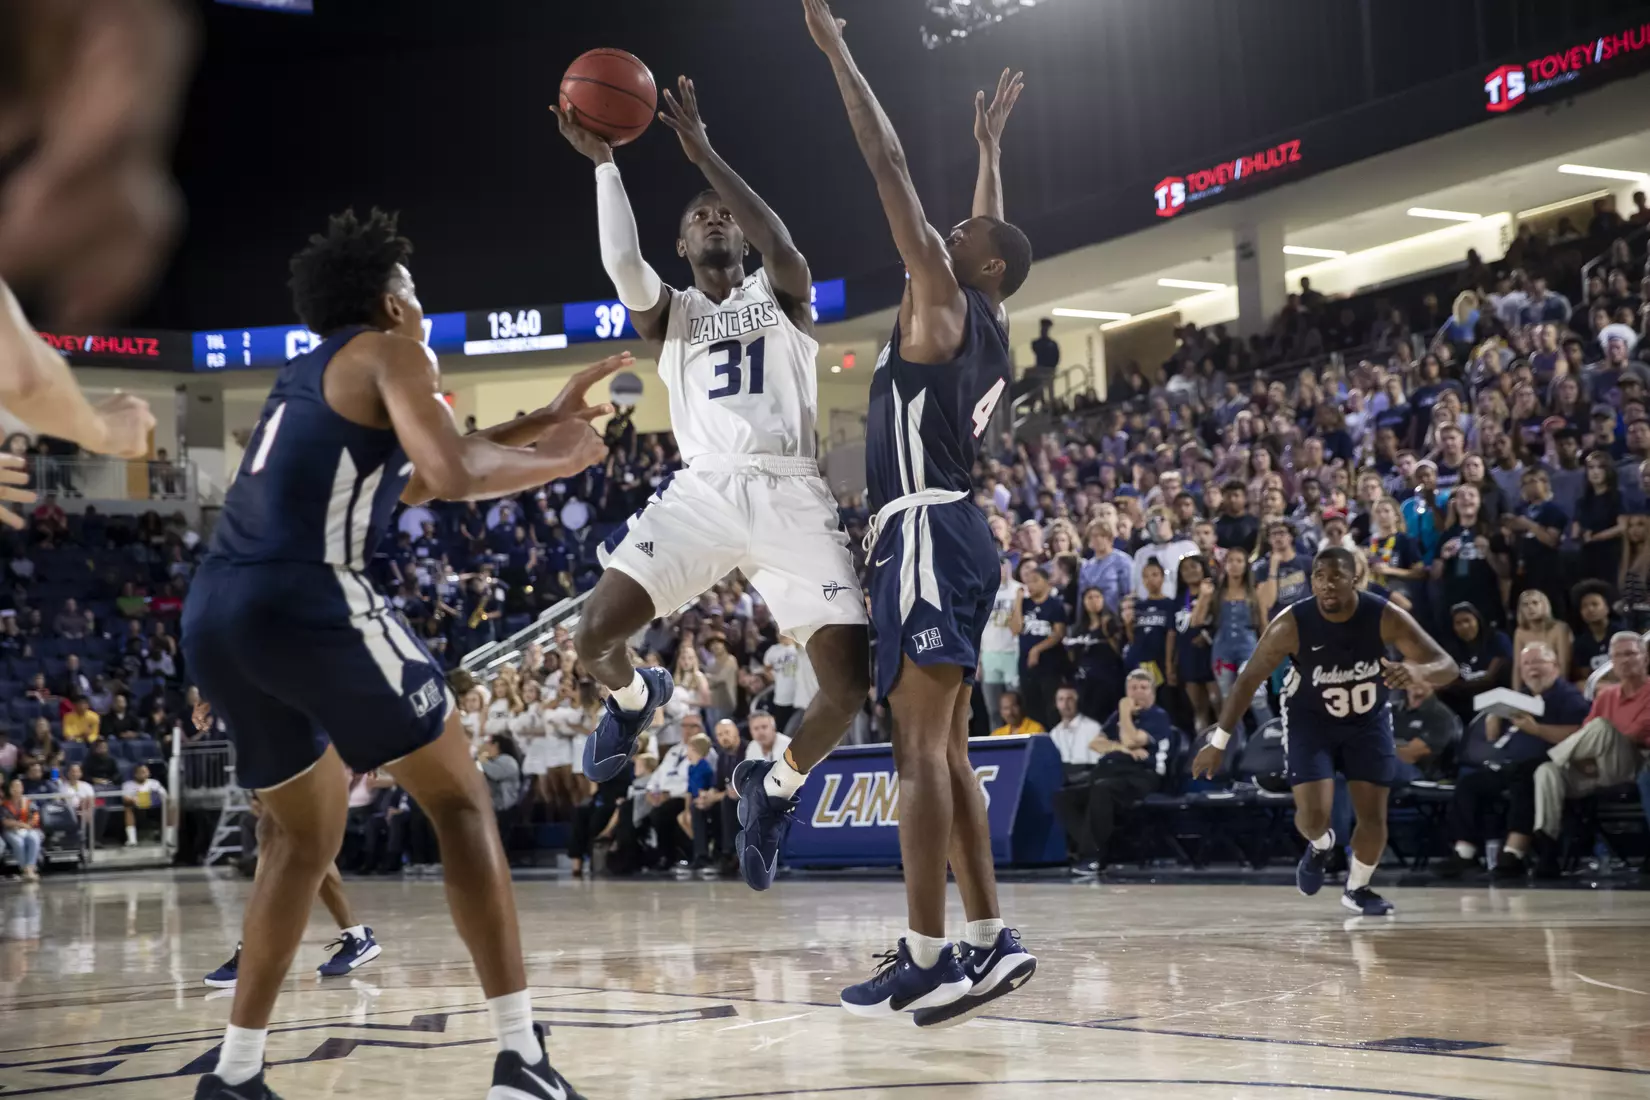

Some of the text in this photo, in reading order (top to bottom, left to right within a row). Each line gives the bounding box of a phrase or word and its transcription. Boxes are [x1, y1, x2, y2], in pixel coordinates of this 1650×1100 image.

[487, 309, 541, 339] 13:40
[595, 304, 627, 338] 39
[690, 301, 778, 346] LANCERS
[37, 331, 159, 356] OVEY/SHULTZ
[708, 335, 766, 400] 31
[971, 377, 1006, 440] 4
[1321, 682, 1377, 718] 30
